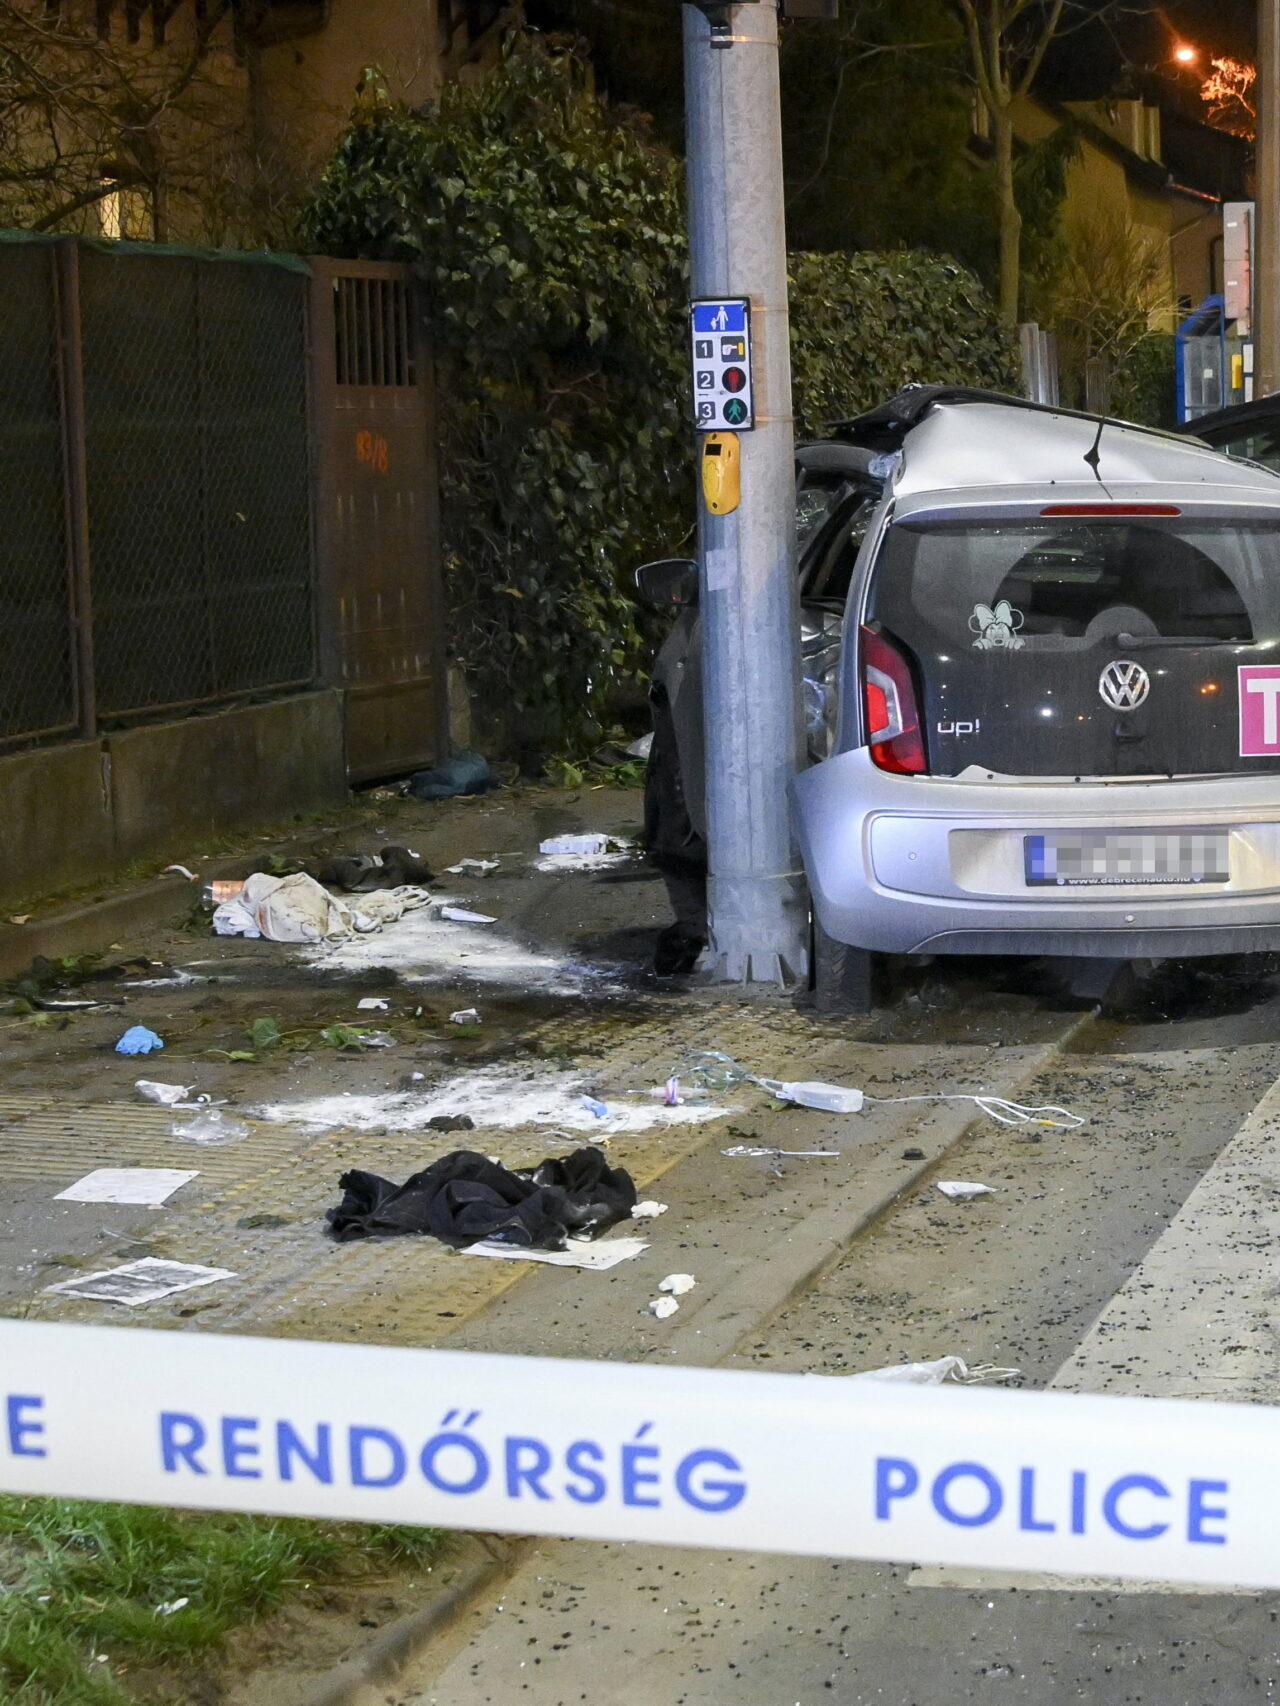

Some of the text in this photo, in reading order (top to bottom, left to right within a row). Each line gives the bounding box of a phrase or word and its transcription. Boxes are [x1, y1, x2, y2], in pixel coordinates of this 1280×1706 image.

[700, 373, 711, 387] 2
[702, 404, 712, 418] 3
[937, 718, 981, 737] up!
[160, 1410, 747, 1513] RENDŐRSÉG
[875, 1457, 1228, 1545] POLICE
